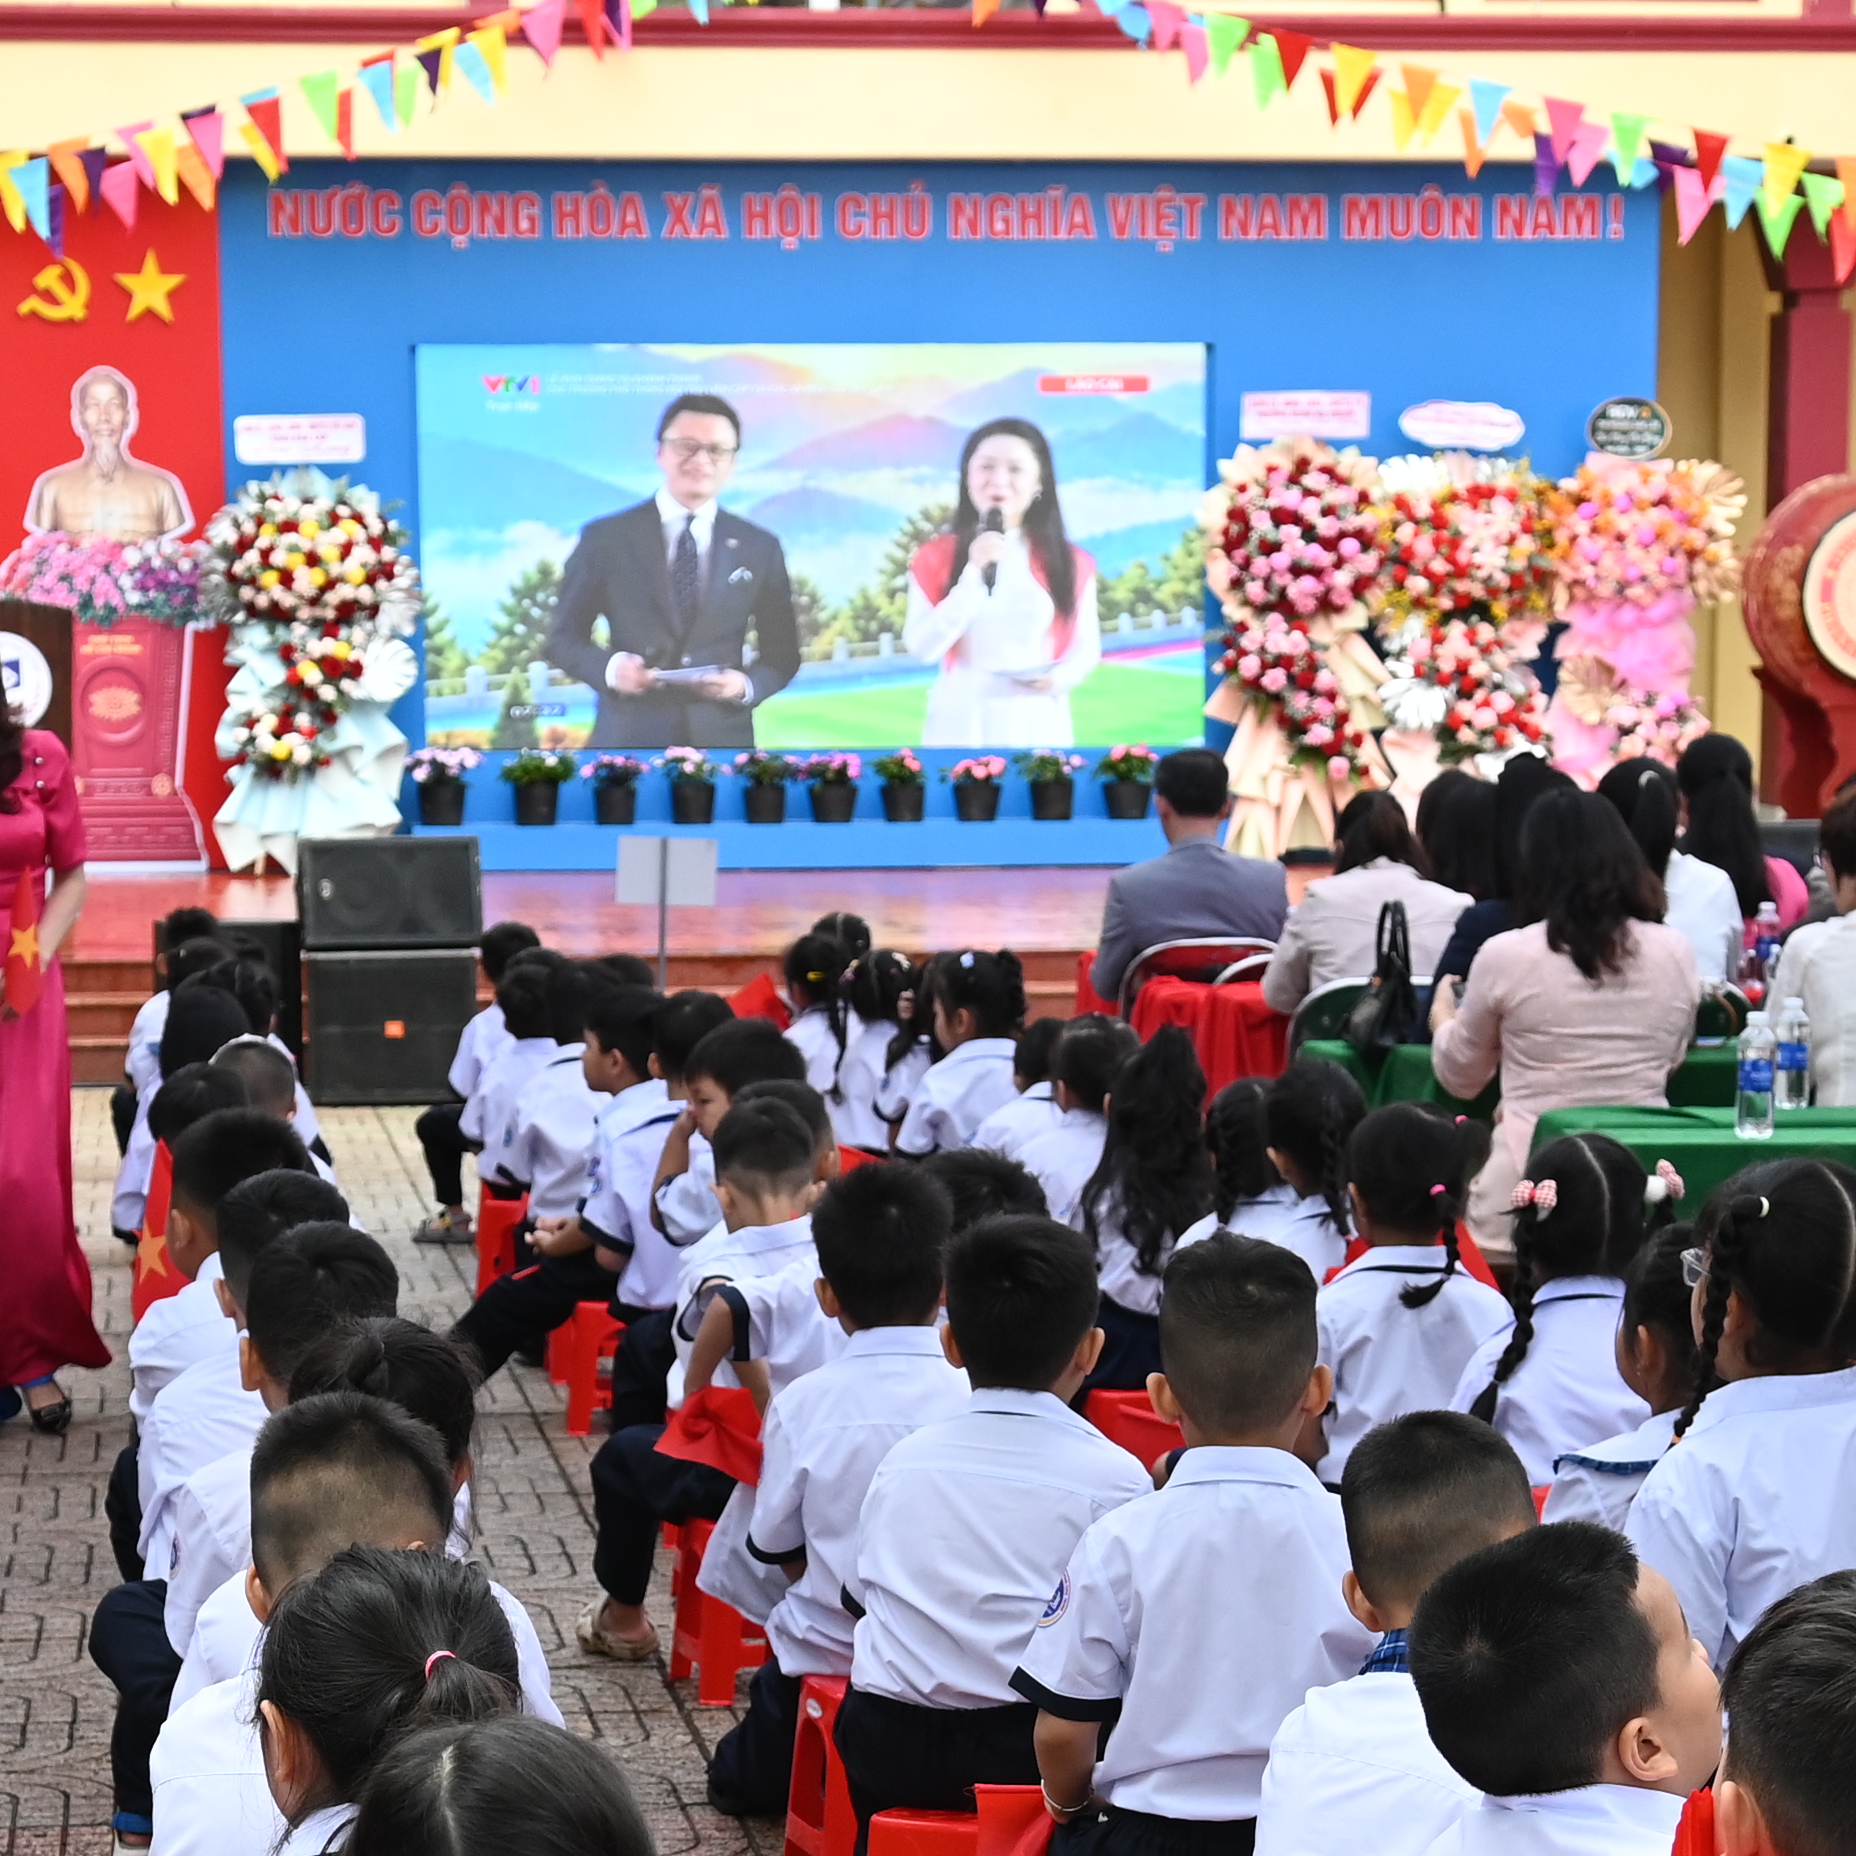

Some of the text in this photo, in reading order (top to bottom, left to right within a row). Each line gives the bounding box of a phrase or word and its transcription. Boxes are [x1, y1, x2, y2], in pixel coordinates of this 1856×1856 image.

[268, 180, 403, 239] NƯỚC
[410, 181, 542, 250] CỘNG
[551, 180, 650, 240] HÒA
[661, 181, 729, 240] XÃ
[744, 183, 822, 251] HỘI
[835, 179, 931, 240] CHỦ
[945, 182, 1096, 240] NGHĨA
[1104, 182, 1206, 252] VIỆT
[1217, 191, 1328, 240] NAM
[1340, 182, 1482, 240] MUÔN
